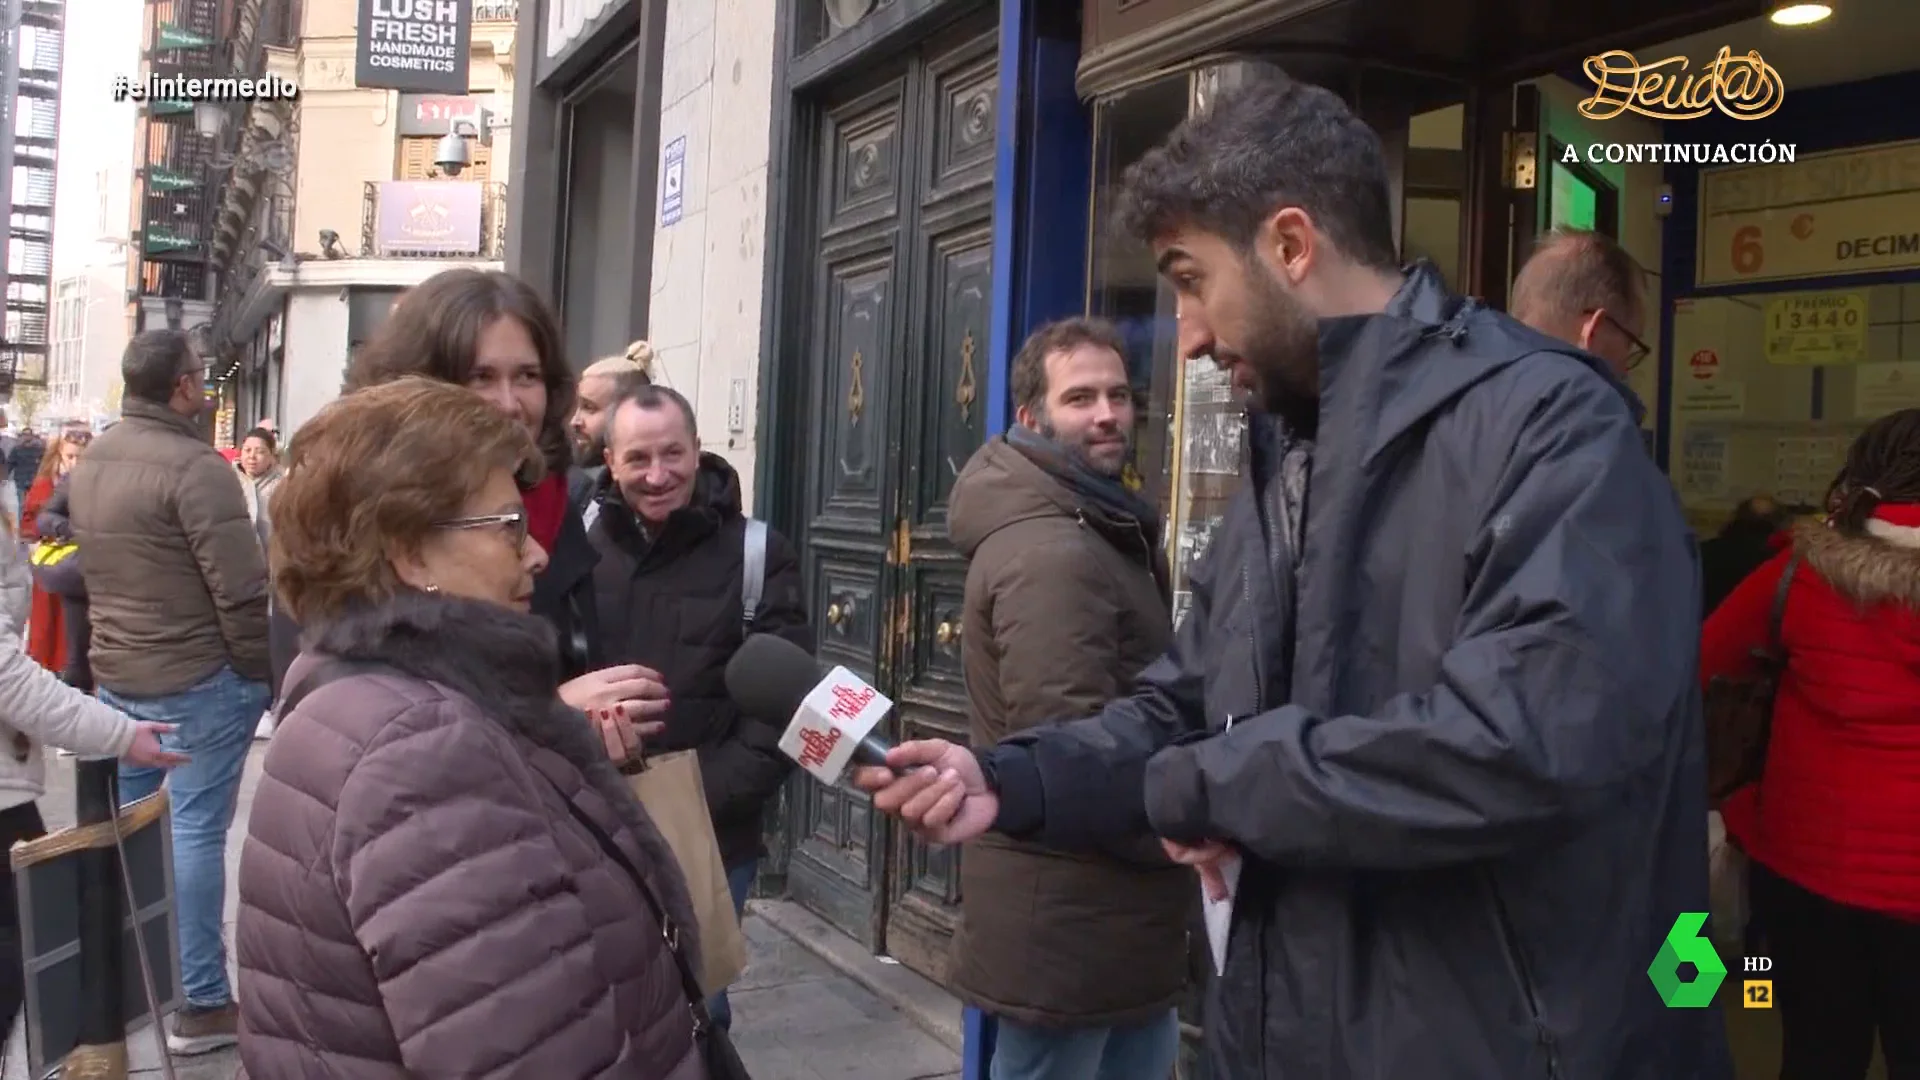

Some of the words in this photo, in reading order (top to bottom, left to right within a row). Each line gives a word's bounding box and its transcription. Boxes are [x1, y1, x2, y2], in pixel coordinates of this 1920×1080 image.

[372, 0, 457, 23] LUSH
[371, 20, 456, 45] FRESH
[370, 41, 455, 58] HANDMADE
[370, 55, 454, 72] COSMETICS
[1731, 225, 1764, 275] 6
[1836, 232, 1920, 261] DECIM
[1775, 308, 1858, 330] 13440
[829, 688, 857, 718] INTER
[845, 687, 876, 719] MEDIO
[798, 731, 826, 766] INTER
[812, 727, 842, 767] MEDIO
